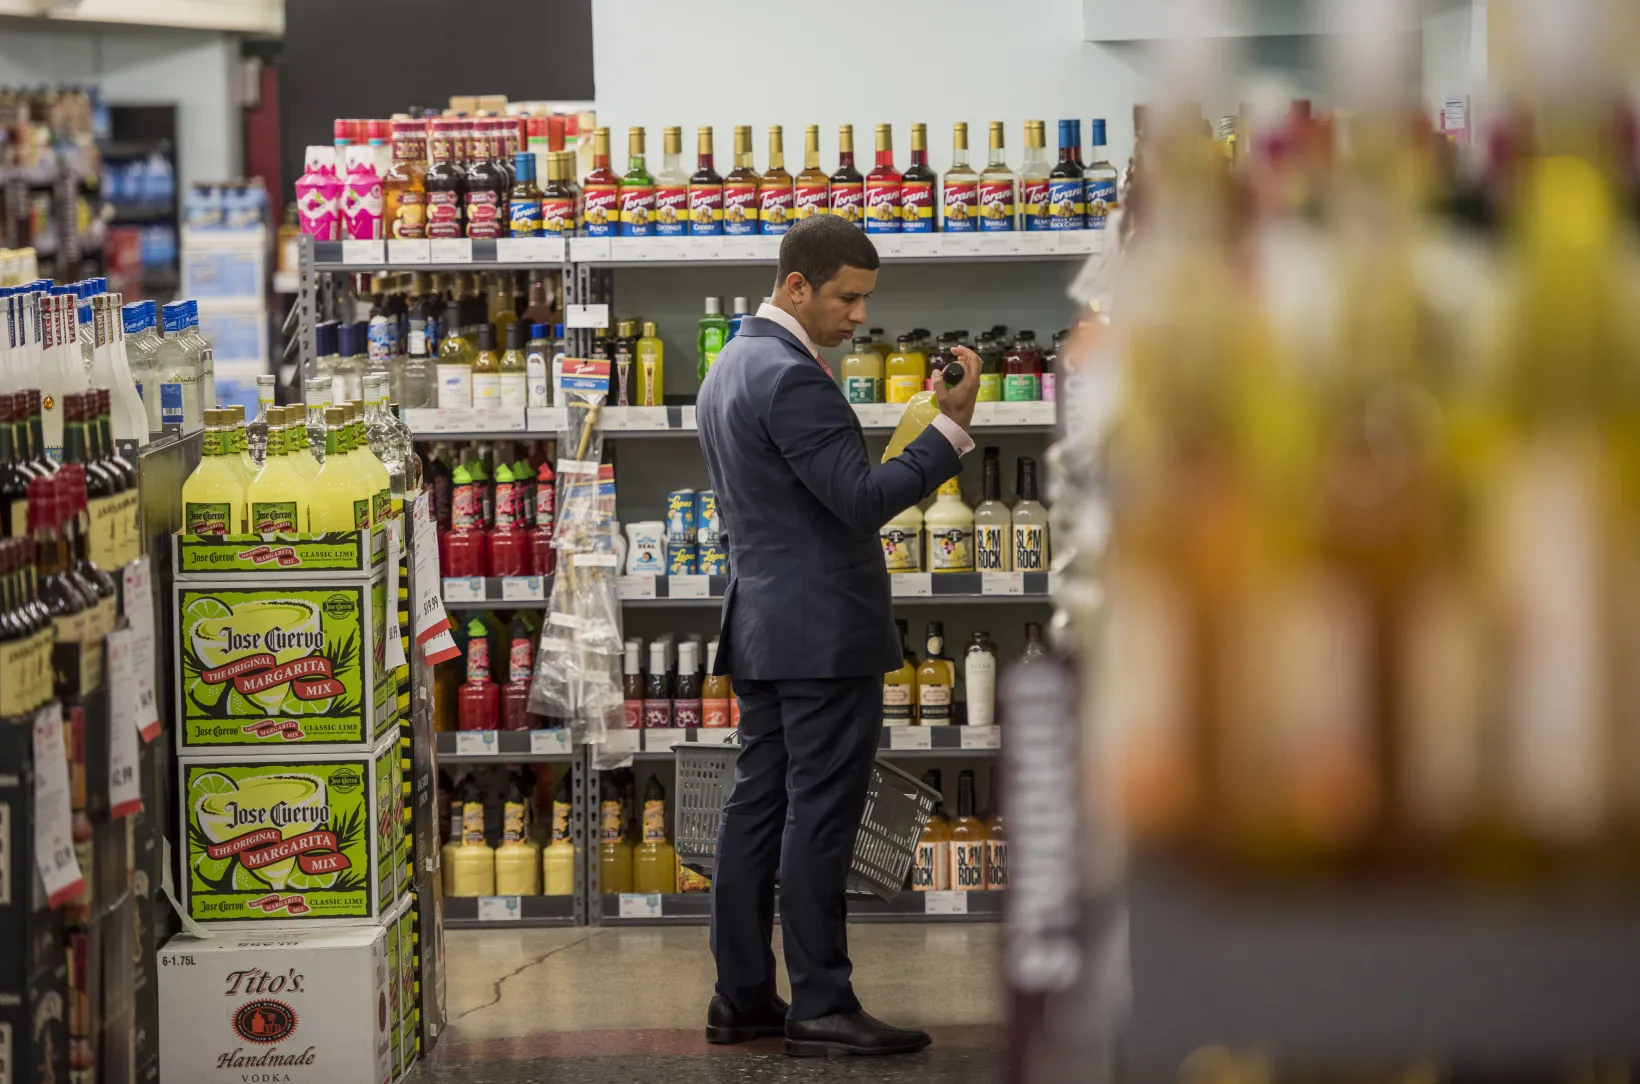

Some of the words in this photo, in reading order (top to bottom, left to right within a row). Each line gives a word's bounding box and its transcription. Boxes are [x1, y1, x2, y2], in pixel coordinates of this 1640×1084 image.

[584, 191, 616, 211] Torani
[689, 190, 721, 211] Torani
[795, 188, 827, 207] Torani
[944, 186, 976, 207] Torani
[980, 186, 1012, 206] Torani
[1050, 184, 1082, 204] Torani
[670, 495, 692, 511] Lopez
[191, 552, 210, 564] Jose
[210, 552, 235, 564] Cuervo
[256, 549, 292, 562] MARGARITA
[674, 548, 696, 564] Lopez
[703, 548, 725, 564] Lopez
[978, 550, 1002, 568] ROCK
[1016, 550, 1042, 568] ROCK
[424, 596, 439, 616] $19.99
[219, 627, 261, 654] Jose
[264, 626, 325, 653] Cuervo
[208, 669, 226, 682] THE
[227, 656, 272, 676] ORIGINAL
[243, 659, 327, 692] MARGARITA
[306, 682, 334, 697] MIX
[195, 726, 212, 738] Jose
[212, 726, 239, 738] Cuervo
[260, 722, 296, 736] MARGARITA
[224, 802, 267, 830] Jose
[269, 800, 330, 828] Cuervo
[213, 844, 232, 858] THE
[233, 831, 278, 852] ORIGINAL
[248, 834, 332, 867] MARGARITA
[311, 857, 339, 872] MIX
[958, 866, 982, 886] ROCK
[200, 900, 218, 913] Jose
[218, 900, 244, 912] Cuervo
[265, 896, 302, 912] MARGARITA
[162, 956, 196, 966] 6-1.75L
[224, 967, 305, 997] Tito's
[216, 1046, 317, 1070] Handmade
[241, 1074, 291, 1083] VODKA
